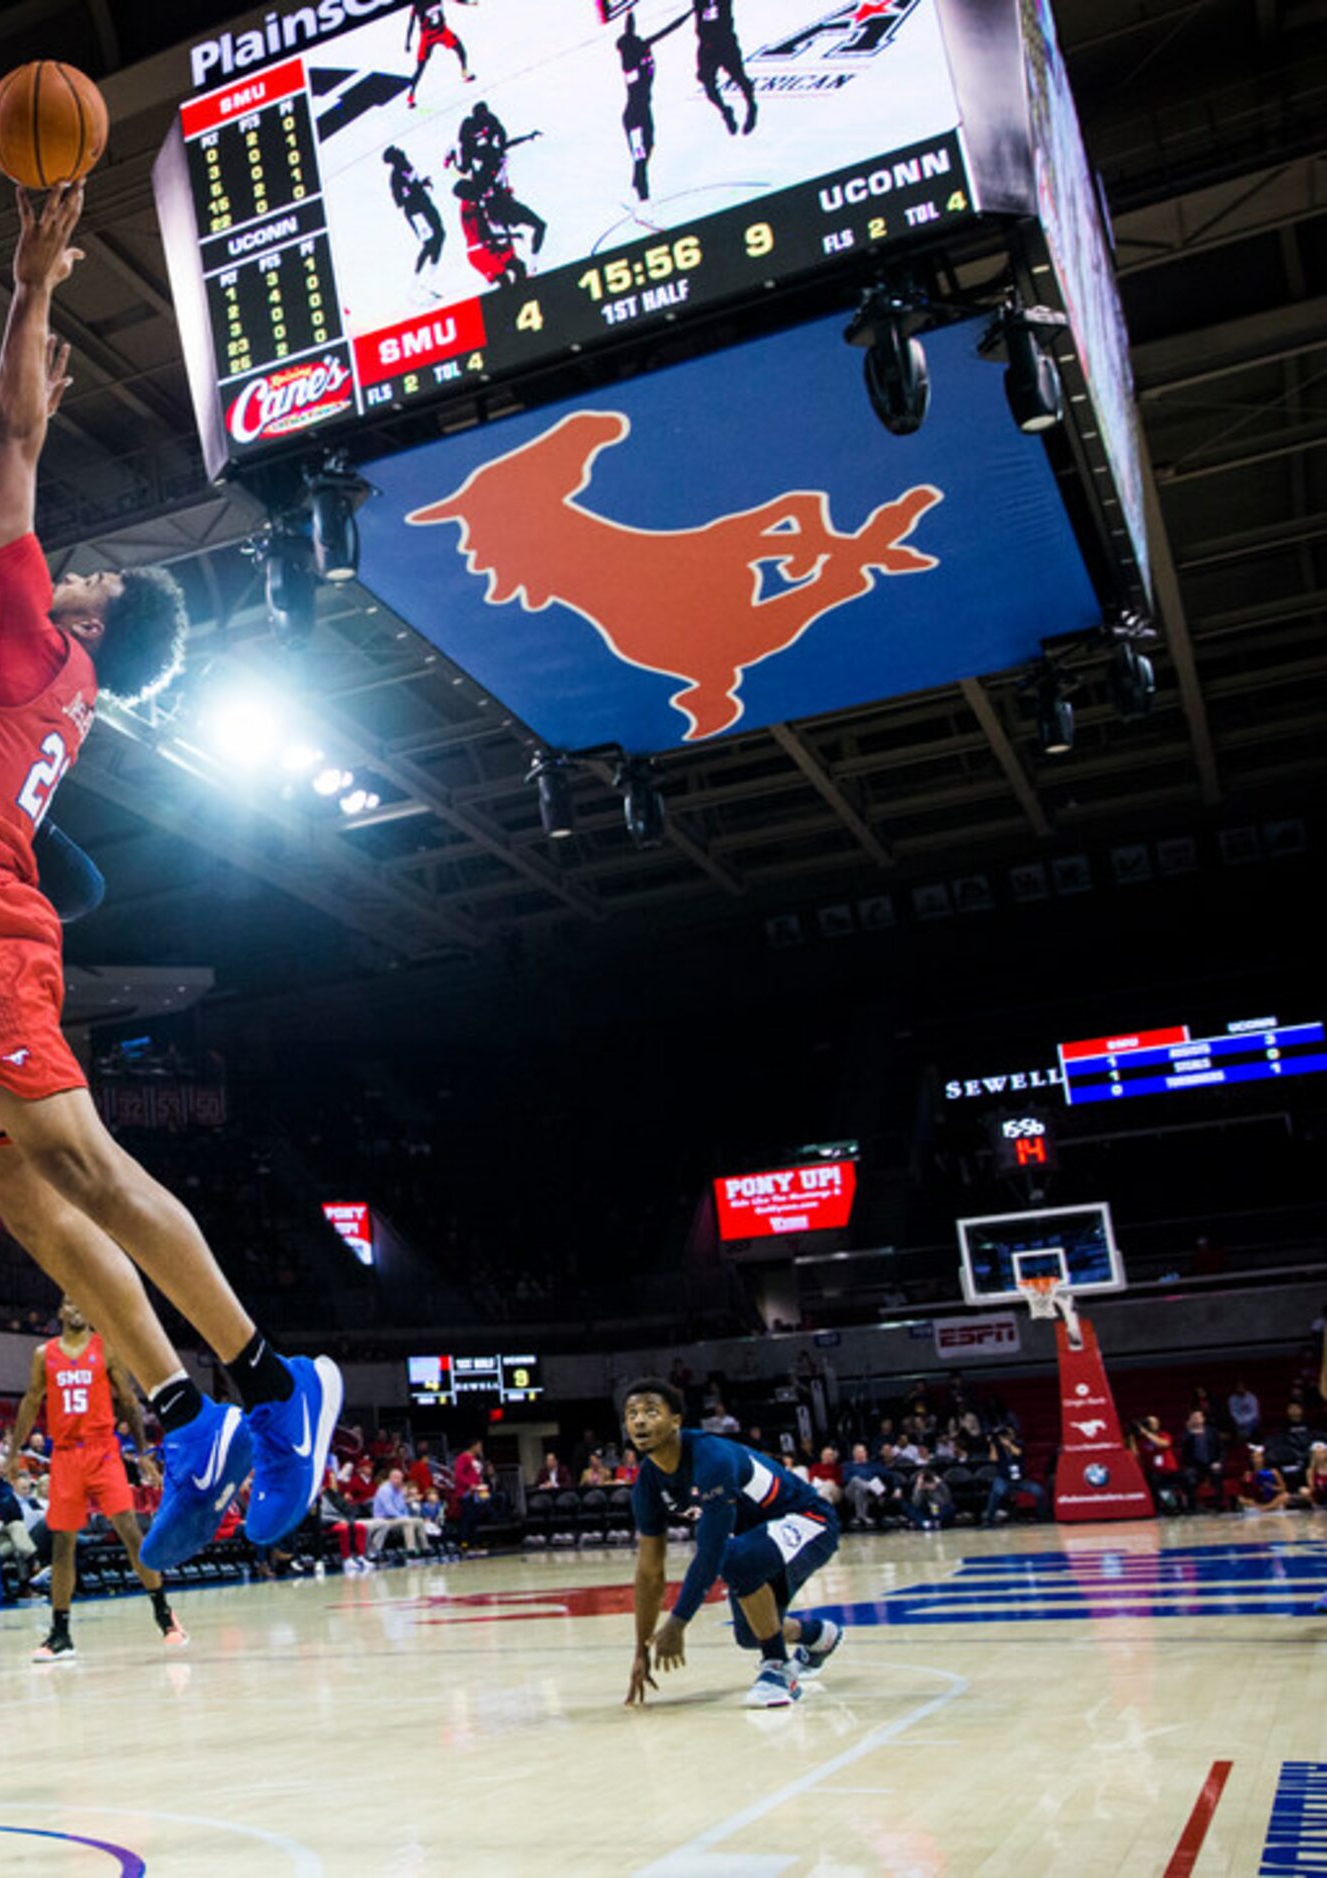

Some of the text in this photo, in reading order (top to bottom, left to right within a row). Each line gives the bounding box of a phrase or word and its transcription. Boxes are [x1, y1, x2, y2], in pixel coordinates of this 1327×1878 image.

[219, 83, 266, 114] SMU
[205, 148, 218, 163] 0
[282, 116, 295, 131] 0
[248, 148, 261, 164] 0
[285, 133, 296, 148] 1
[251, 165, 263, 181] 0
[288, 150, 300, 166] 0
[253, 182, 266, 198] 2
[290, 167, 302, 182] 1
[818, 148, 951, 213] UCONN
[256, 199, 268, 215] 0
[293, 184, 305, 200] 0
[228, 216, 299, 255] UCONN
[743, 221, 774, 258] 9
[822, 228, 855, 255] FLS
[867, 216, 888, 241] 2
[946, 191, 967, 214] 4
[225, 257, 316, 301] 1 3 1
[577, 234, 703, 302] 15:56
[227, 274, 319, 320] 2 4 0
[230, 292, 322, 337] 3 0 0
[601, 279, 690, 326] 1ST HALF
[227, 310, 324, 357] 23 0 0
[516, 300, 544, 332] 4
[314, 328, 327, 343] 0
[378, 317, 458, 365] SMU
[367, 383, 393, 405] FLS
[403, 374, 420, 394] 2
[467, 352, 484, 371] 4
[232, 354, 350, 442] Cane's
[17, 732, 71, 829] 2
[946, 1068, 1062, 1099] SEWELL
[1016, 1136, 1046, 1166] 14
[725, 1165, 841, 1199] PONY UP!
[938, 1322, 1015, 1348] ESPN
[56, 1369, 93, 1387] SMU
[513, 1369, 529, 1387] 9
[62, 1388, 89, 1414] 15
